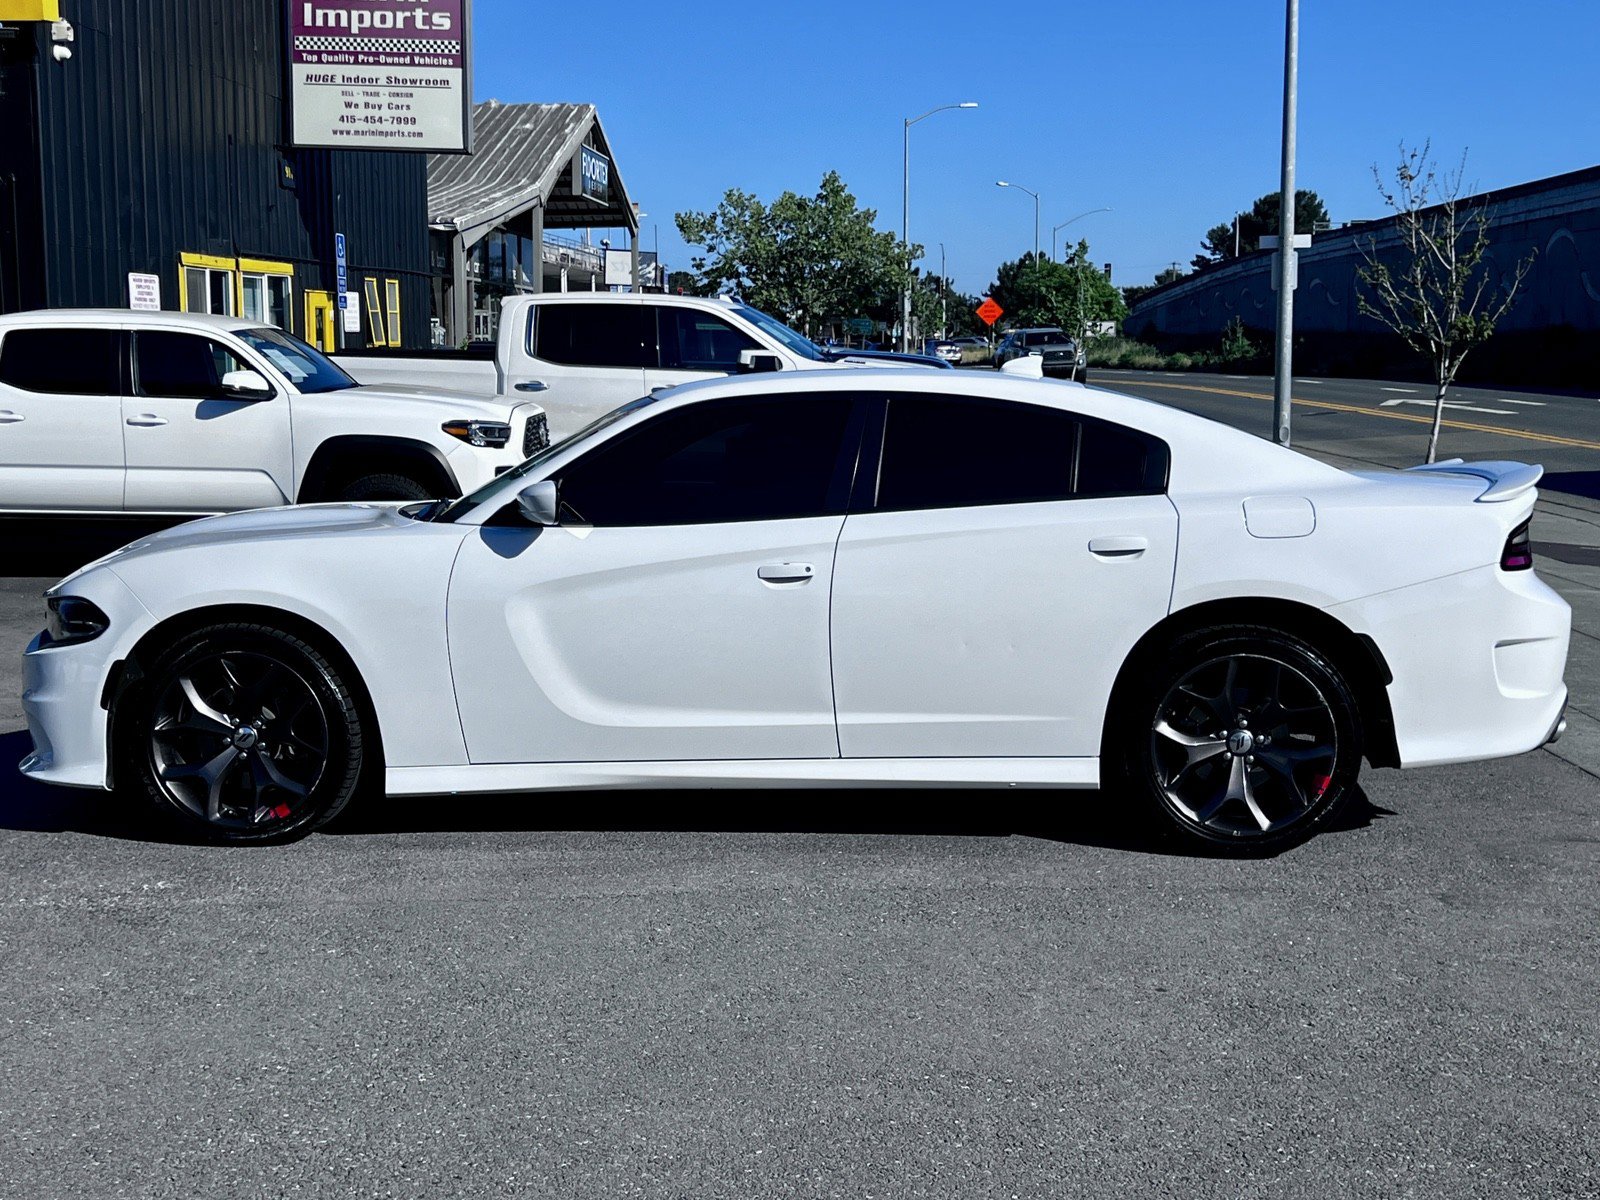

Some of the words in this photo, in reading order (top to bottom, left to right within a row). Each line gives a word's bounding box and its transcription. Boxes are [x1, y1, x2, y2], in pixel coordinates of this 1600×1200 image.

[303, 2, 451, 34] Imports
[302, 53, 318, 62] Top
[321, 53, 354, 64] Quality
[358, 54, 410, 64] Pre-Owned
[414, 56, 453, 66] Vehicles
[305, 74, 337, 83] HUGE
[341, 75, 380, 84] Indoor
[385, 76, 450, 86] Showroom
[344, 101, 359, 109] We
[363, 102, 382, 111] Buy
[387, 102, 411, 111] Cars
[338, 115, 417, 126] 415-454-7999
[331, 129, 424, 138] www.marinimports.com
